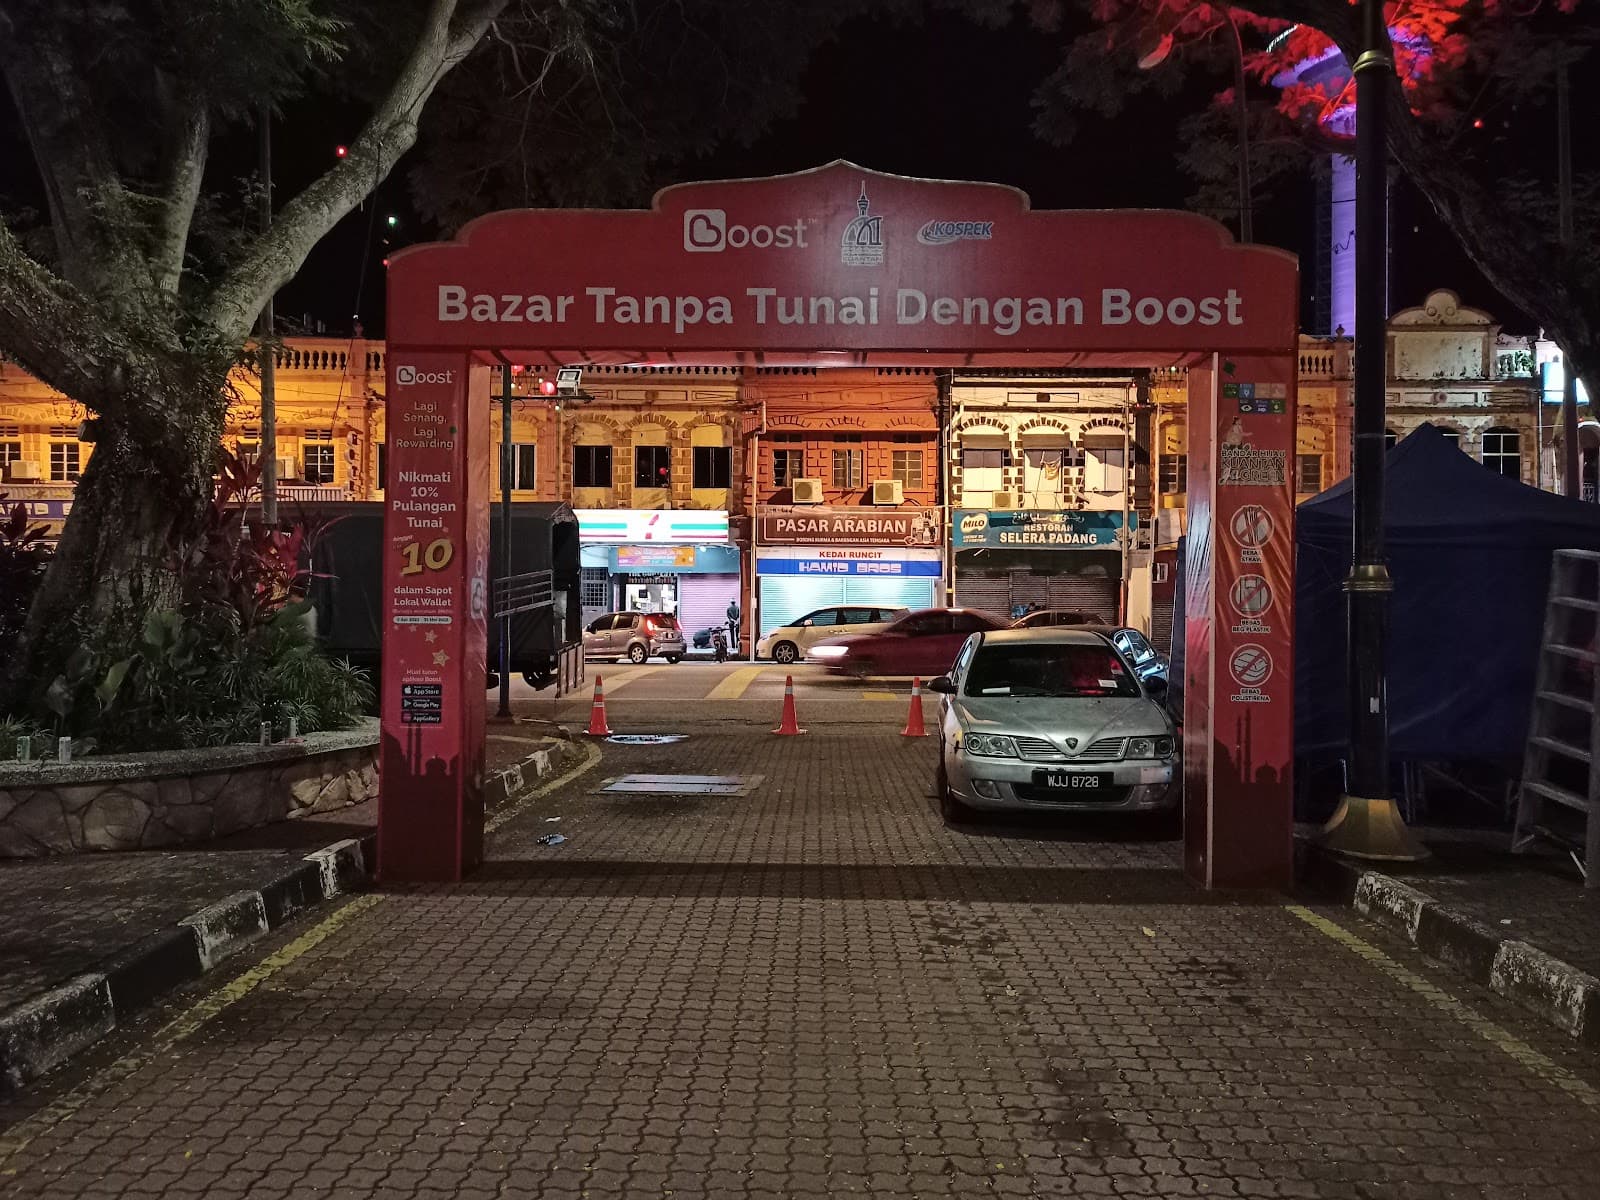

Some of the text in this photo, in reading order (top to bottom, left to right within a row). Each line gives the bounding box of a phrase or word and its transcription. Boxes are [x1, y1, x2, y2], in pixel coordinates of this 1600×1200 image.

[934, 222, 993, 236] KOSPEK
[438, 285, 1244, 336] Bazar Tanpa Tunai Dengan Boost
[414, 401, 437, 412] Lagi
[403, 413, 447, 424] Senang,
[413, 427, 437, 438] Lagi
[396, 438, 454, 450] Rewarding
[399, 471, 452, 483] Nikmati
[410, 486, 439, 498] 10%
[392, 500, 457, 514] Pulangan
[406, 516, 443, 528] Tunai
[776, 518, 907, 534] PASAR ARABIAN
[963, 519, 985, 529] MILO
[1023, 524, 1074, 532] RESTORAN
[1000, 532, 1046, 543] SELERA
[1048, 533, 1098, 544] PADANG
[401, 538, 453, 575] 10
[849, 551, 883, 559] RUNCIT
[798, 561, 902, 573] HAMID BROS
[394, 585, 452, 596] dalam Sapot
[393, 597, 452, 607] Lokal Wallet
[1047, 775, 1099, 787] WJJ 8728
